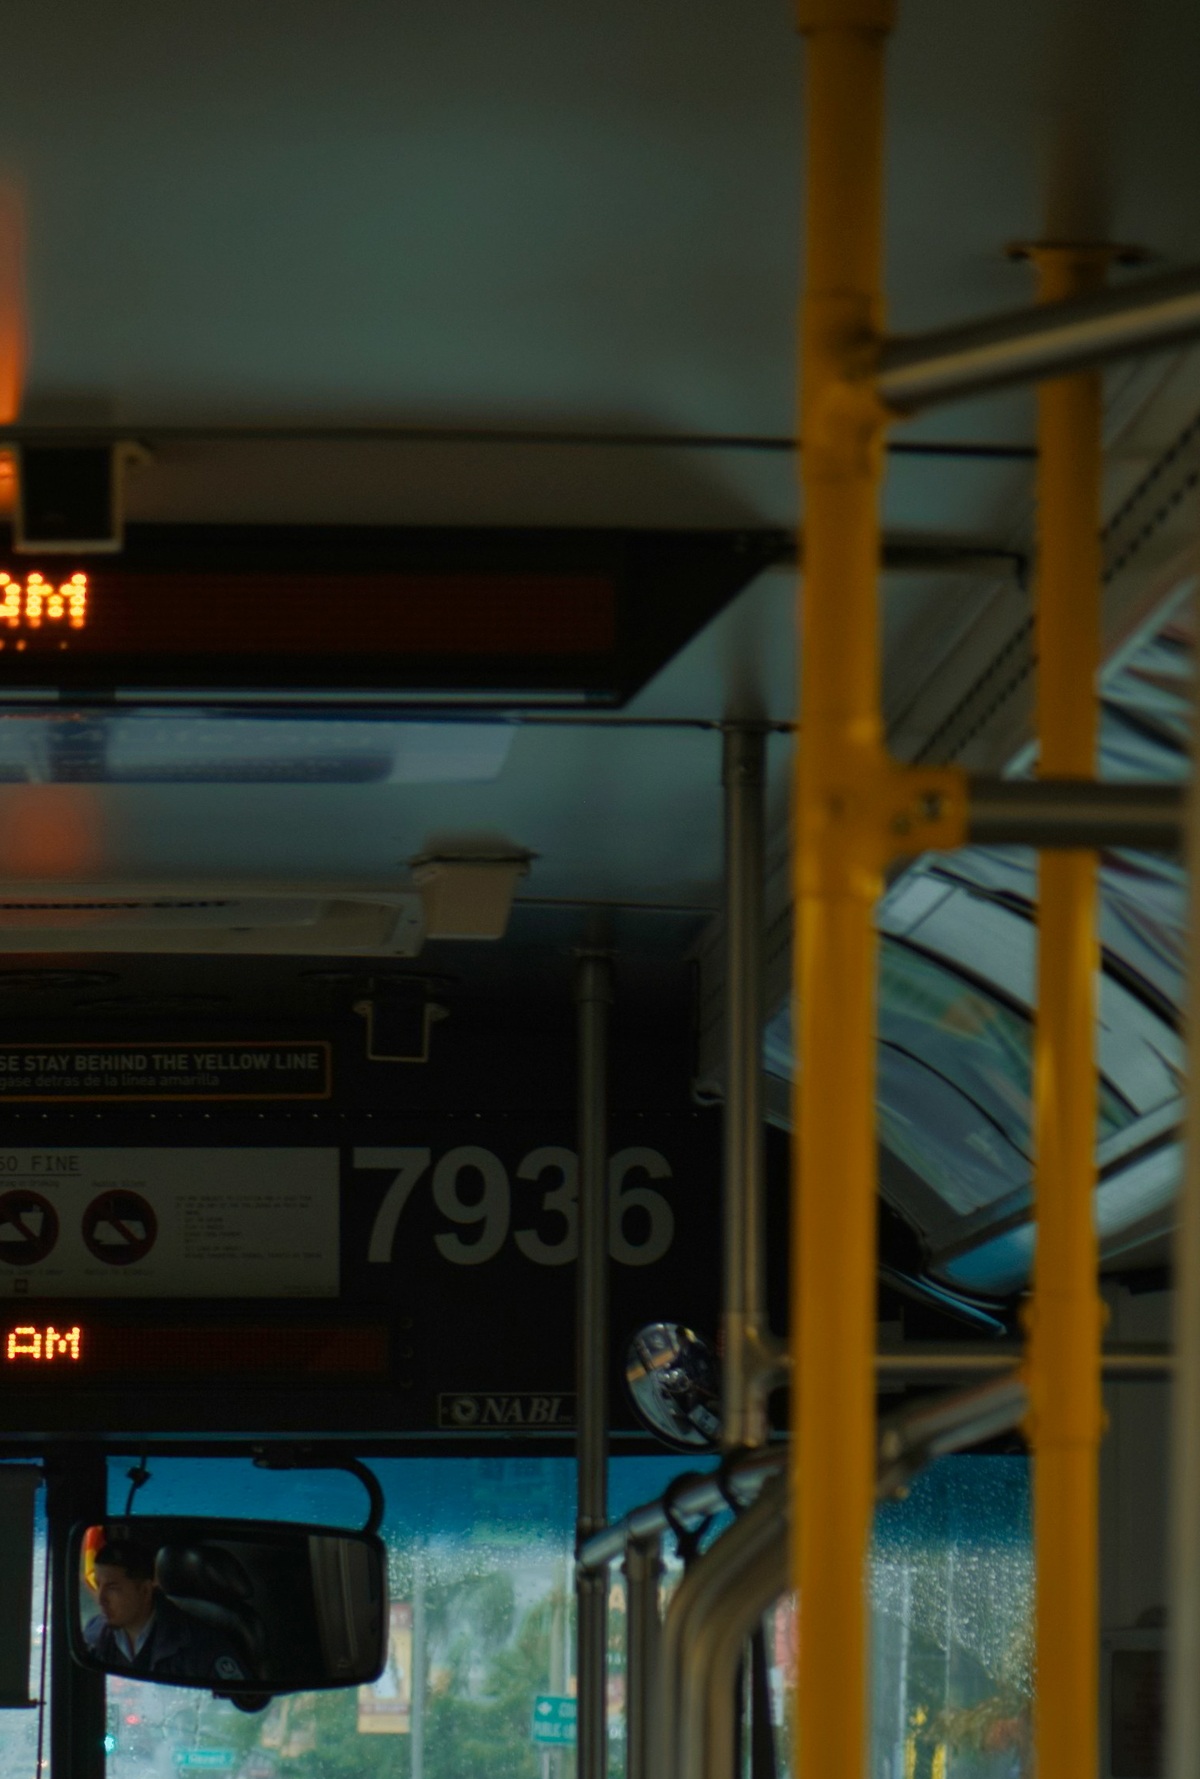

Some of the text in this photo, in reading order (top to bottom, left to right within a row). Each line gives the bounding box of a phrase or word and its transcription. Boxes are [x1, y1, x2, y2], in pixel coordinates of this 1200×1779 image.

[23, 1054, 72, 1072] STAY
[75, 1054, 148, 1071] BEHIND
[151, 1053, 189, 1071] THE
[192, 1053, 271, 1070] YELLOW
[274, 1052, 319, 1070] LINE
[83, 1073, 102, 1087] de
[104, 1073, 118, 1087] la
[158, 1071, 220, 1086] amarilla
[31, 1155, 80, 1172] FINE
[352, 1144, 676, 1267] 7936
[7, 1326, 81, 1360] AM
[481, 1396, 563, 1424] NABI
